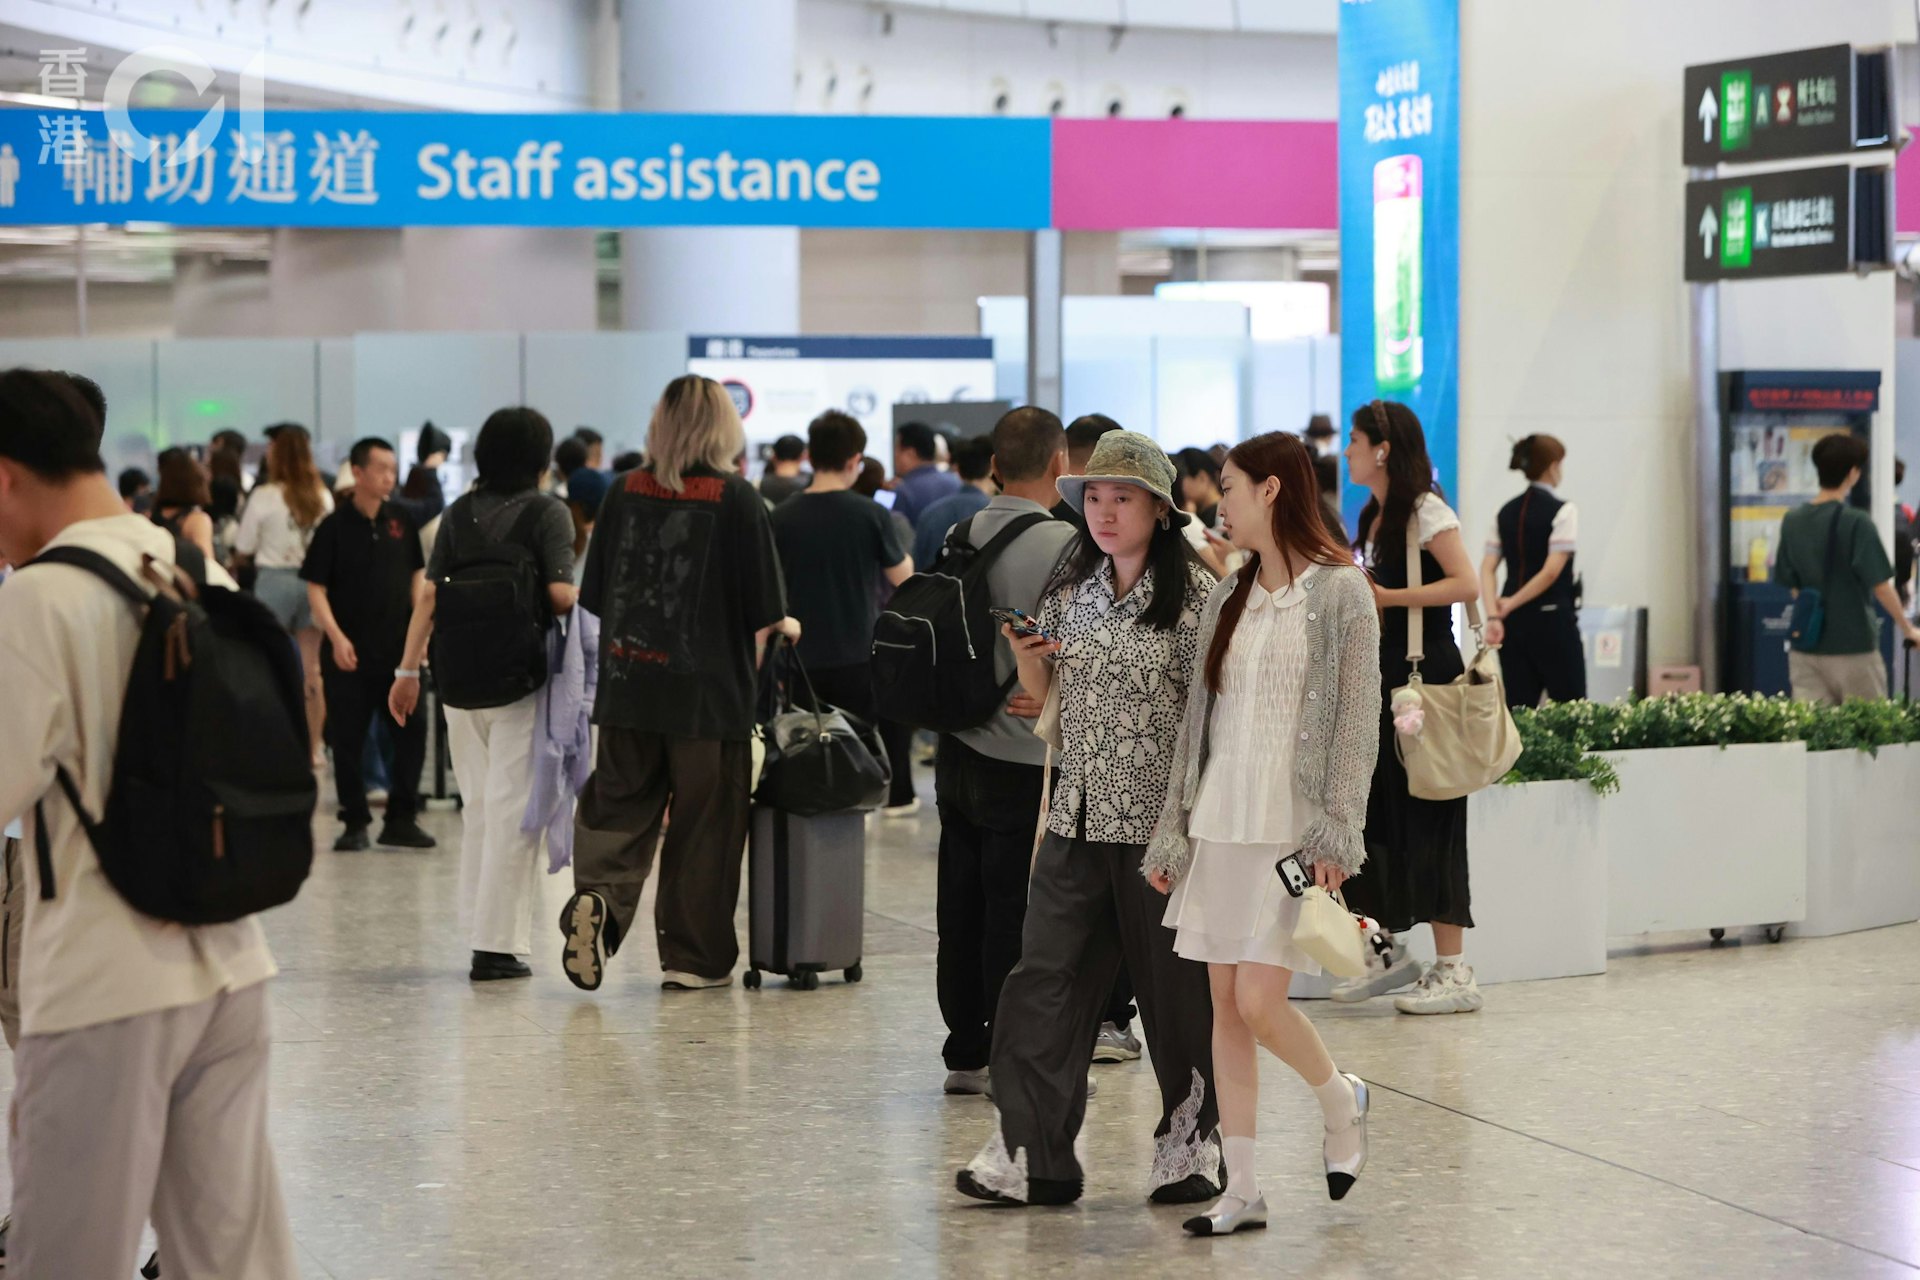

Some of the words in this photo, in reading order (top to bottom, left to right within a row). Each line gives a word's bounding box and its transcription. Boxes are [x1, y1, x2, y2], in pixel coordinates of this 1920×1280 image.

[1755, 91, 1768, 124] A
[62, 129, 380, 205] 輔助通道
[417, 141, 563, 200] Staff
[573, 143, 881, 202] assistance
[1755, 208, 1768, 242] K
